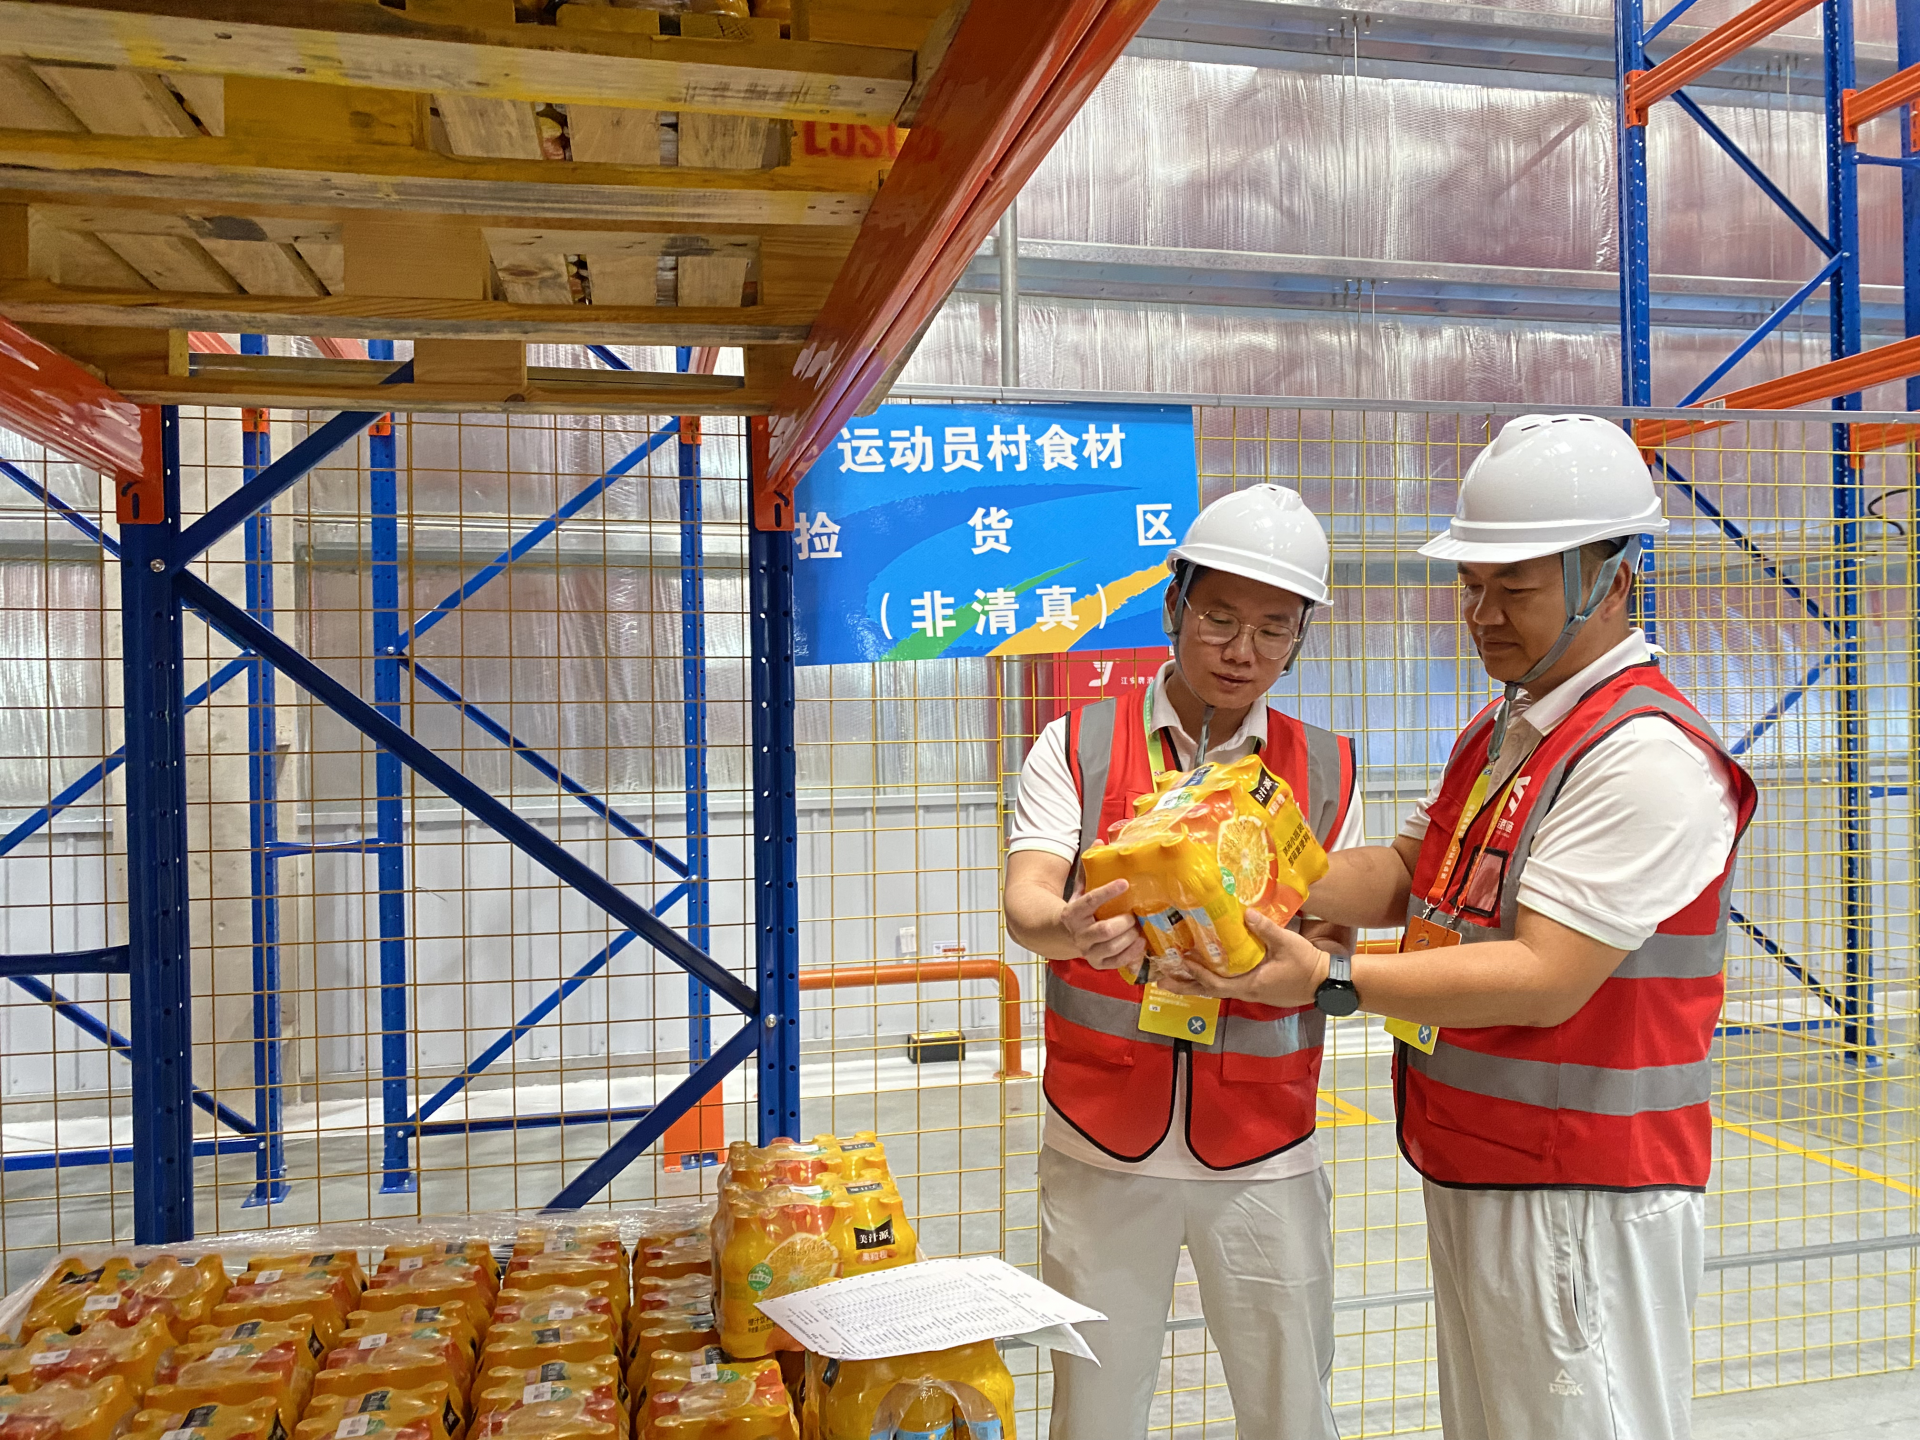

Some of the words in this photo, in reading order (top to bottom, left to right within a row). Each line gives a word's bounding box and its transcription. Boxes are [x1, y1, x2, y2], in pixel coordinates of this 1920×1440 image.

[837, 423, 1126, 473] 运动员村食材
[794, 504, 1177, 560] 捡货区
[880, 583, 1108, 639] （非清真）
[860, 1229, 889, 1244] 美汁源
